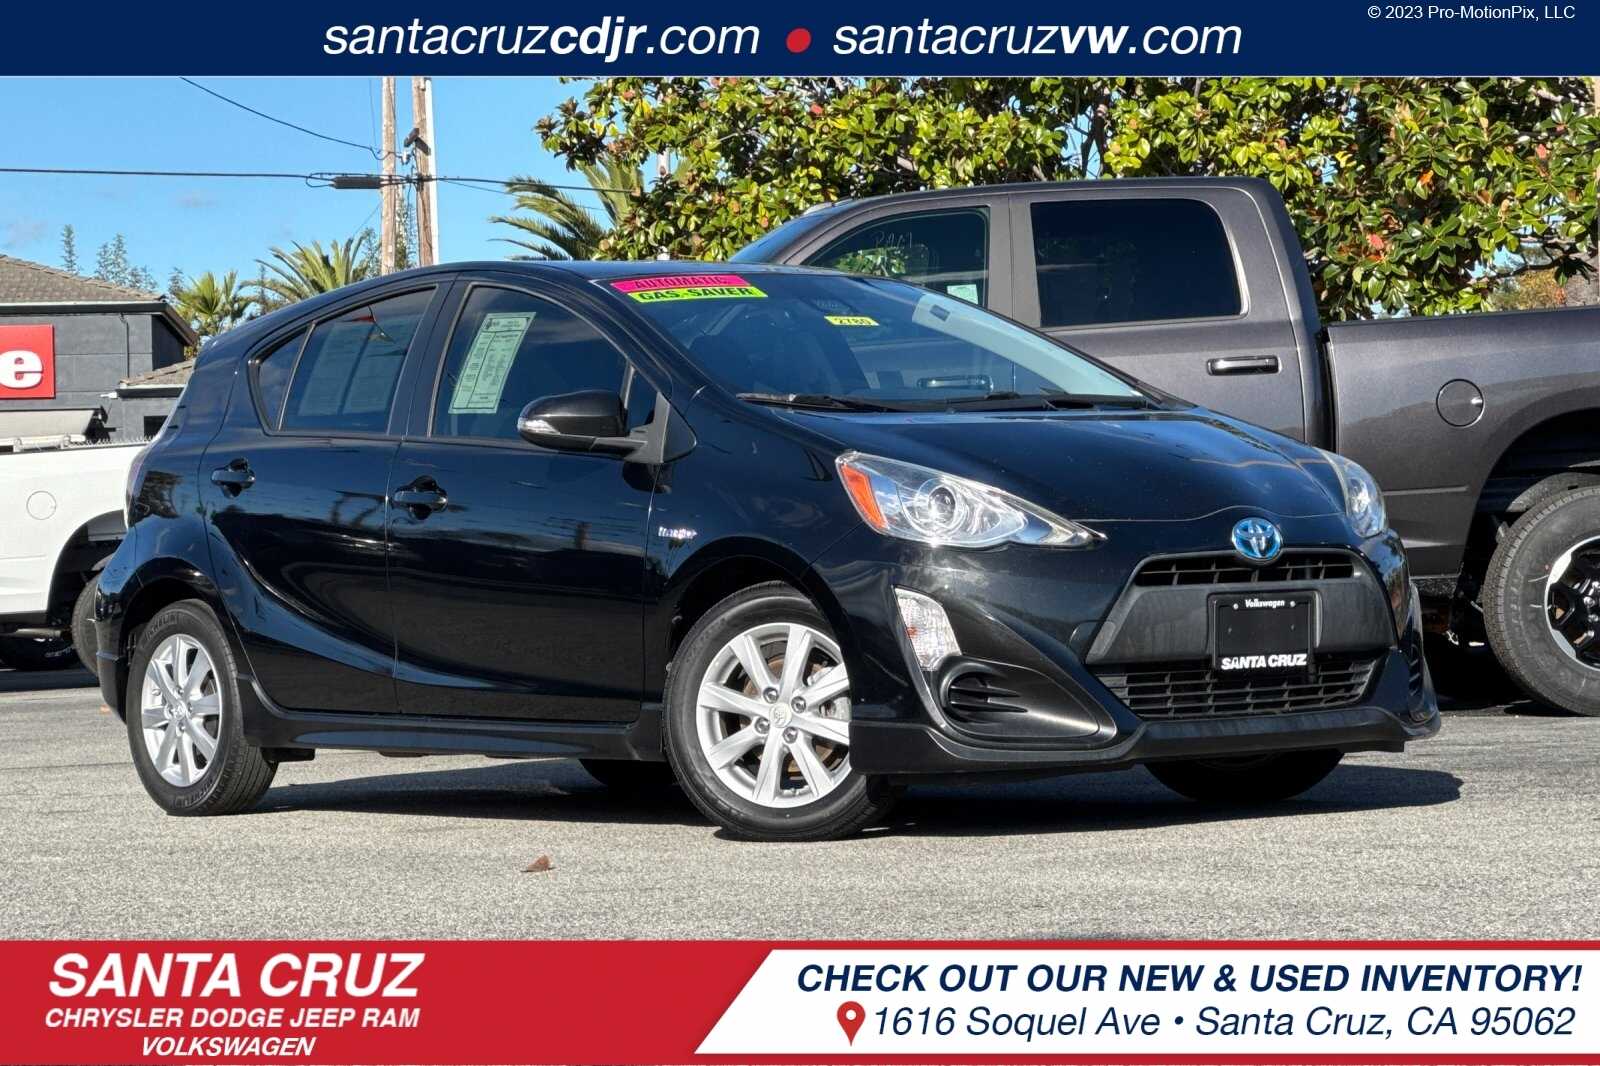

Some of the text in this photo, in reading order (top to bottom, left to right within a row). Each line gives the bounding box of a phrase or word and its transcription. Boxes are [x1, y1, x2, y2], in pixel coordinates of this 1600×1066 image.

[634, 275, 727, 288] AUTOMATIC
[1221, 654, 1307, 670] SANTA CRUZ
